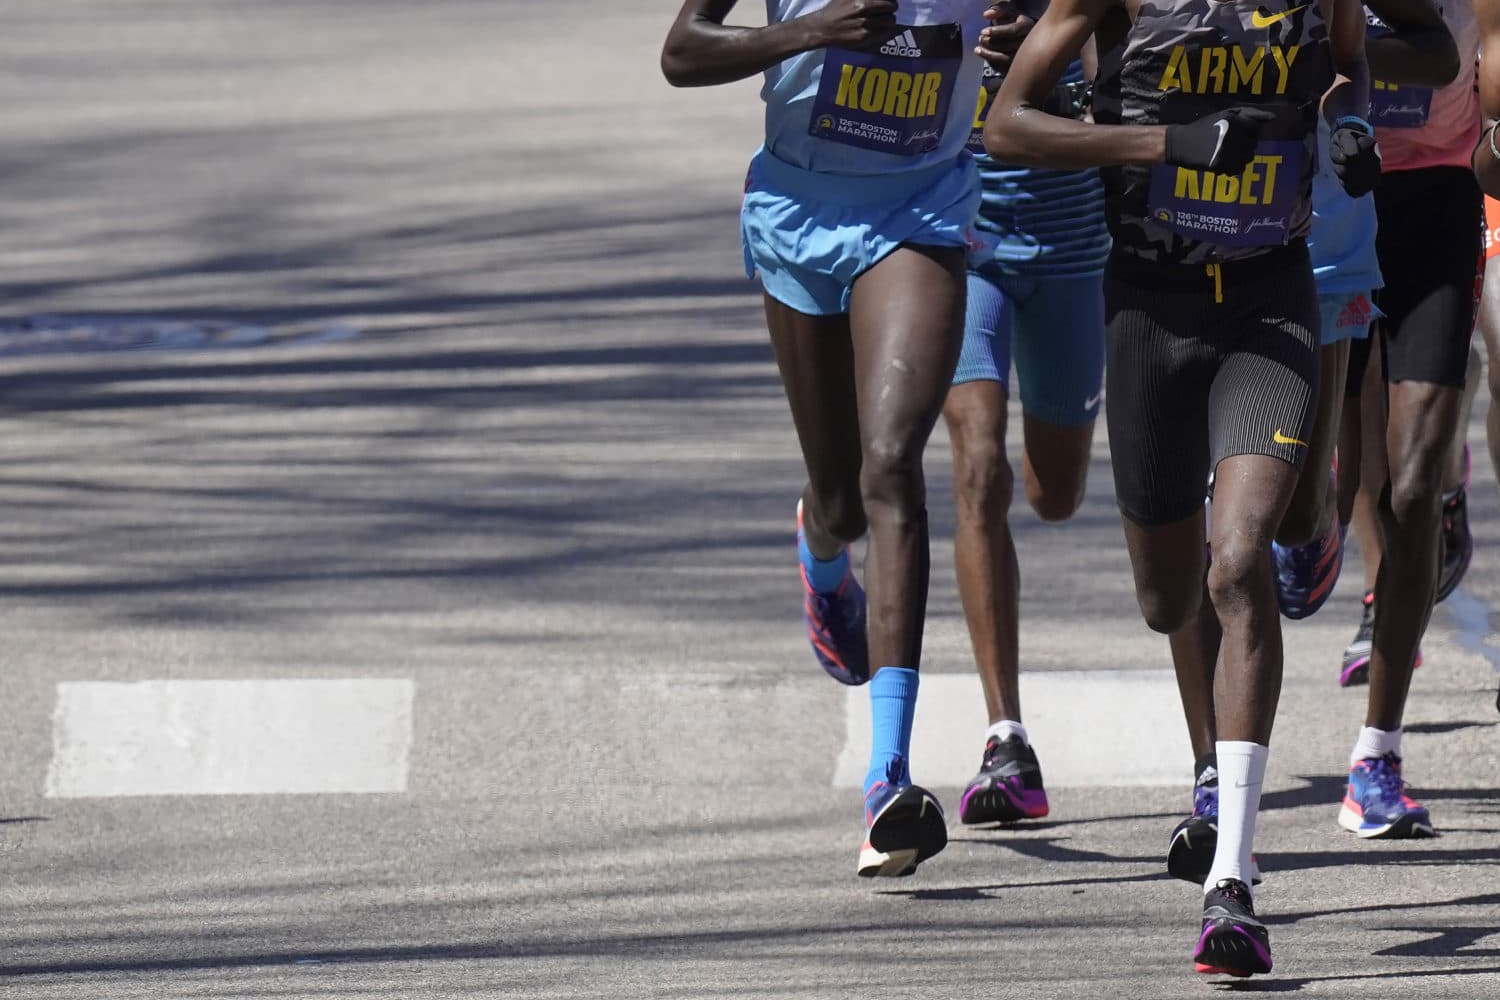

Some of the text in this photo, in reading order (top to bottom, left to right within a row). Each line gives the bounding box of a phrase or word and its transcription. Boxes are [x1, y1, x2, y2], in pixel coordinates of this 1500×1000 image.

[880, 41, 921, 58] adidas
[1157, 45, 1300, 95] ARMY
[835, 63, 942, 118] KORIR
[838, 126, 897, 144] MARATHON
[860, 123, 898, 137] BOSTON
[1176, 219, 1239, 234] MARATHON
[1200, 215, 1239, 226] BOSTON
